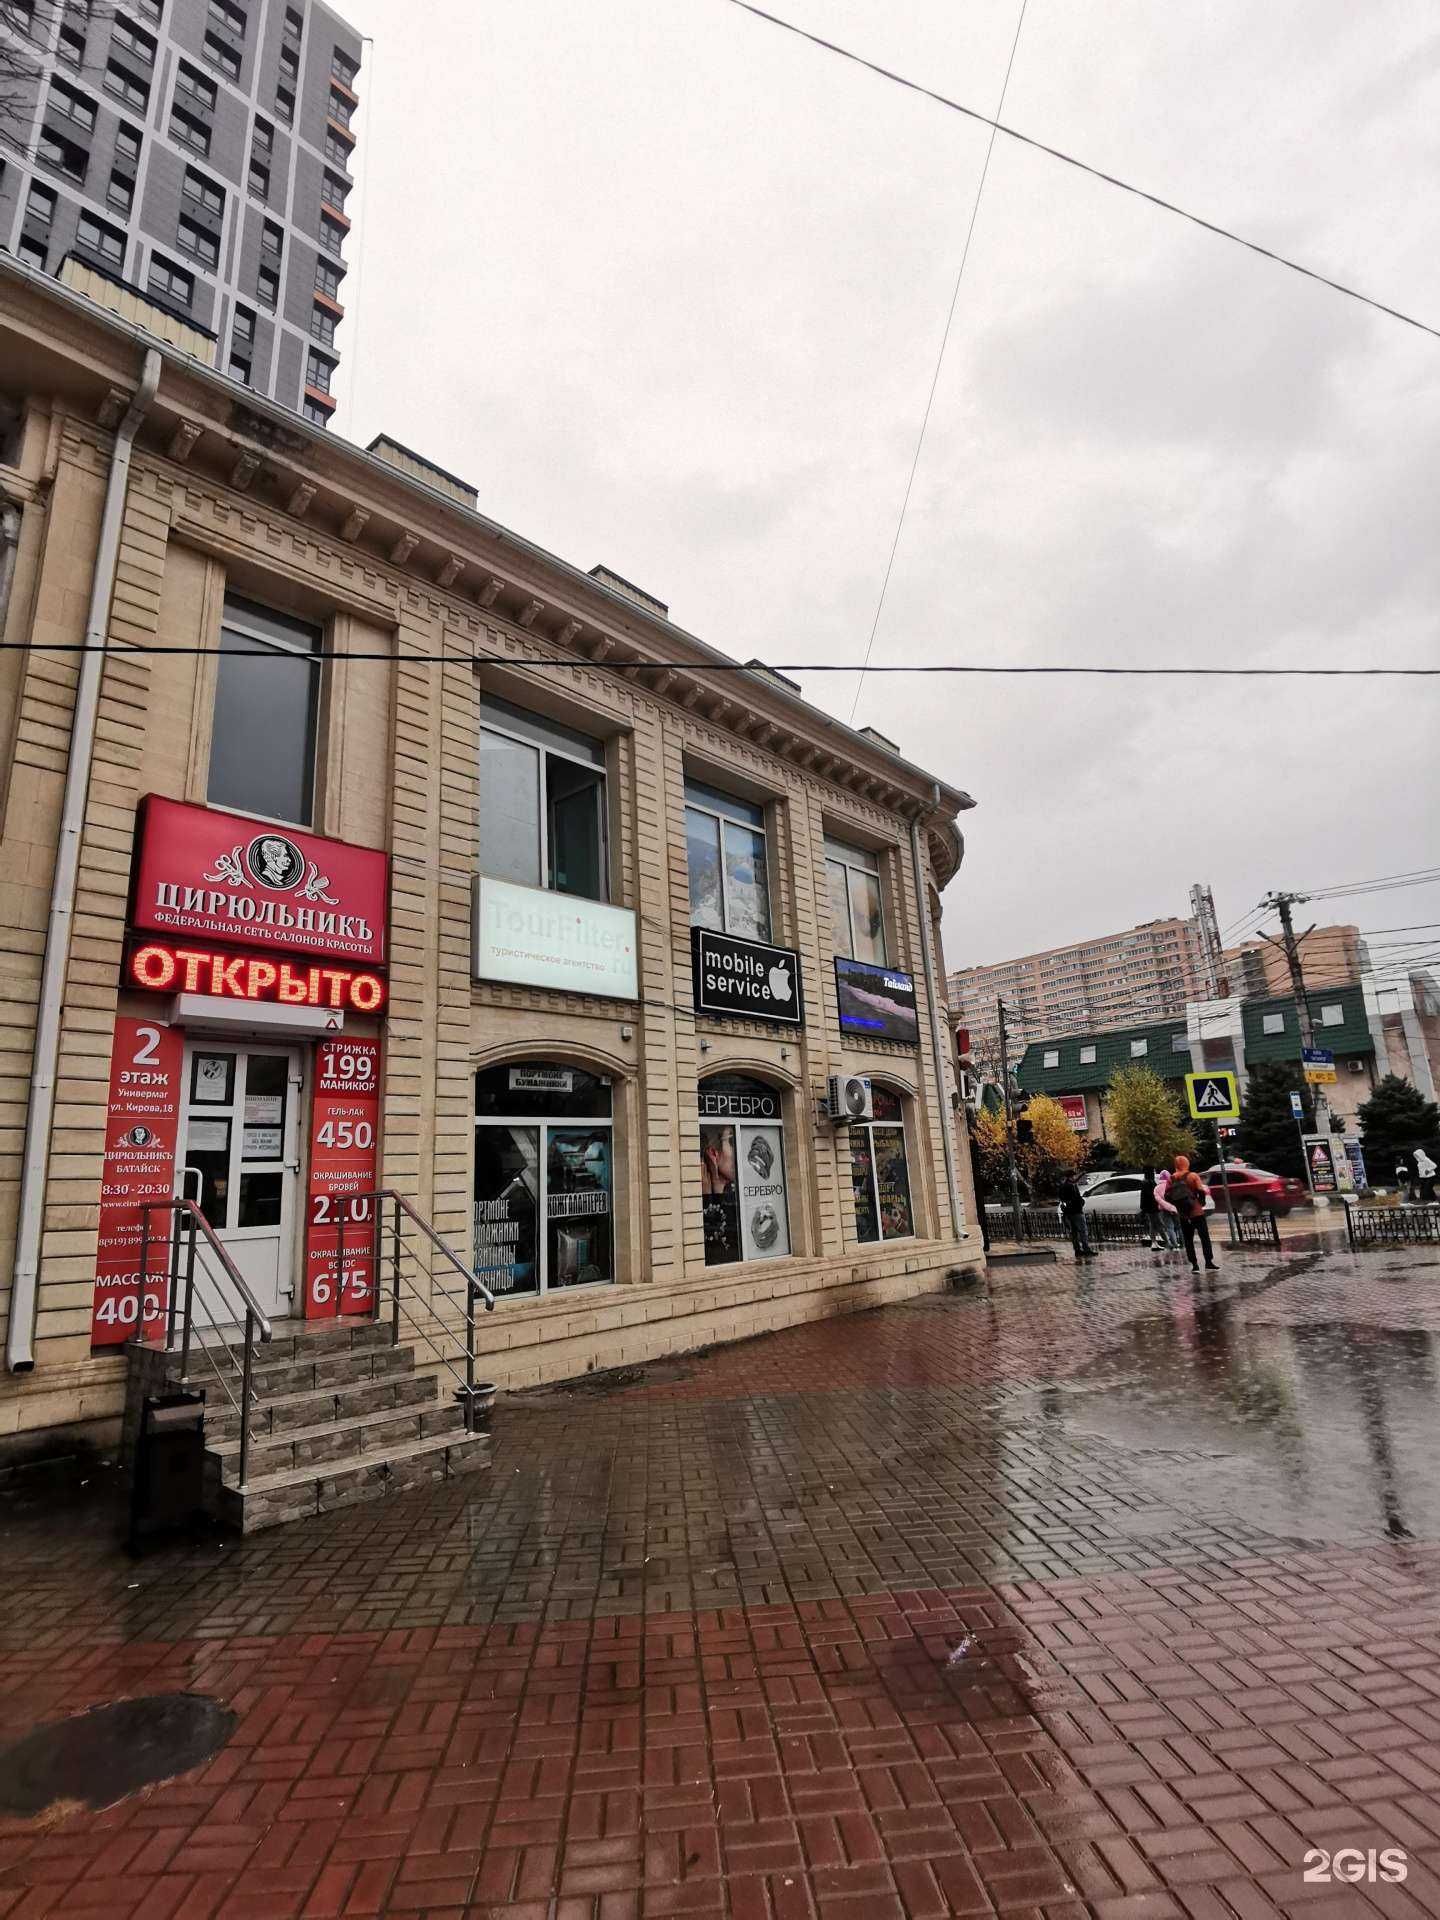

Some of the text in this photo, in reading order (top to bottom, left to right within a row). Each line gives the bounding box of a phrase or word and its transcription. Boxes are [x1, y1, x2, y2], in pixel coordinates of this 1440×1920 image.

[154, 882, 374, 942] ЦИРЮЛЬНИКЪ
[154, 911, 374, 955] ФЕДЕРАЛЬНАЯ СЕТЬ САЛОНОВ КРАСОТЫ
[705, 951, 765, 977] mobile
[132, 945, 384, 1011] ОТКРЫТО
[706, 973, 771, 1000] service
[132, 1027, 161, 1066] 2
[322, 1042, 377, 1055] СТРИЖКА
[120, 1070, 169, 1086] этаж
[320, 1079, 376, 1091] МАНИКЮР
[117, 1088, 168, 1100] Универмаг
[110, 1103, 124, 1112] ул.
[328, 1107, 364, 1116] ГЕЛЬ-ЛАК
[116, 1163, 161, 1174] БАТАЙСК
[313, 1171, 373, 1184] ОКРАШИВАНИЕ
[102, 1184, 129, 1196] 8:30
[138, 1183, 170, 1194] 20:30
[328, 1182, 360, 1191] БРОВЕЙ
[744, 1185, 783, 1197] СЕРЕБРО
[547, 1192, 607, 1217] КОЖГАЛАНТЕРЕЯ
